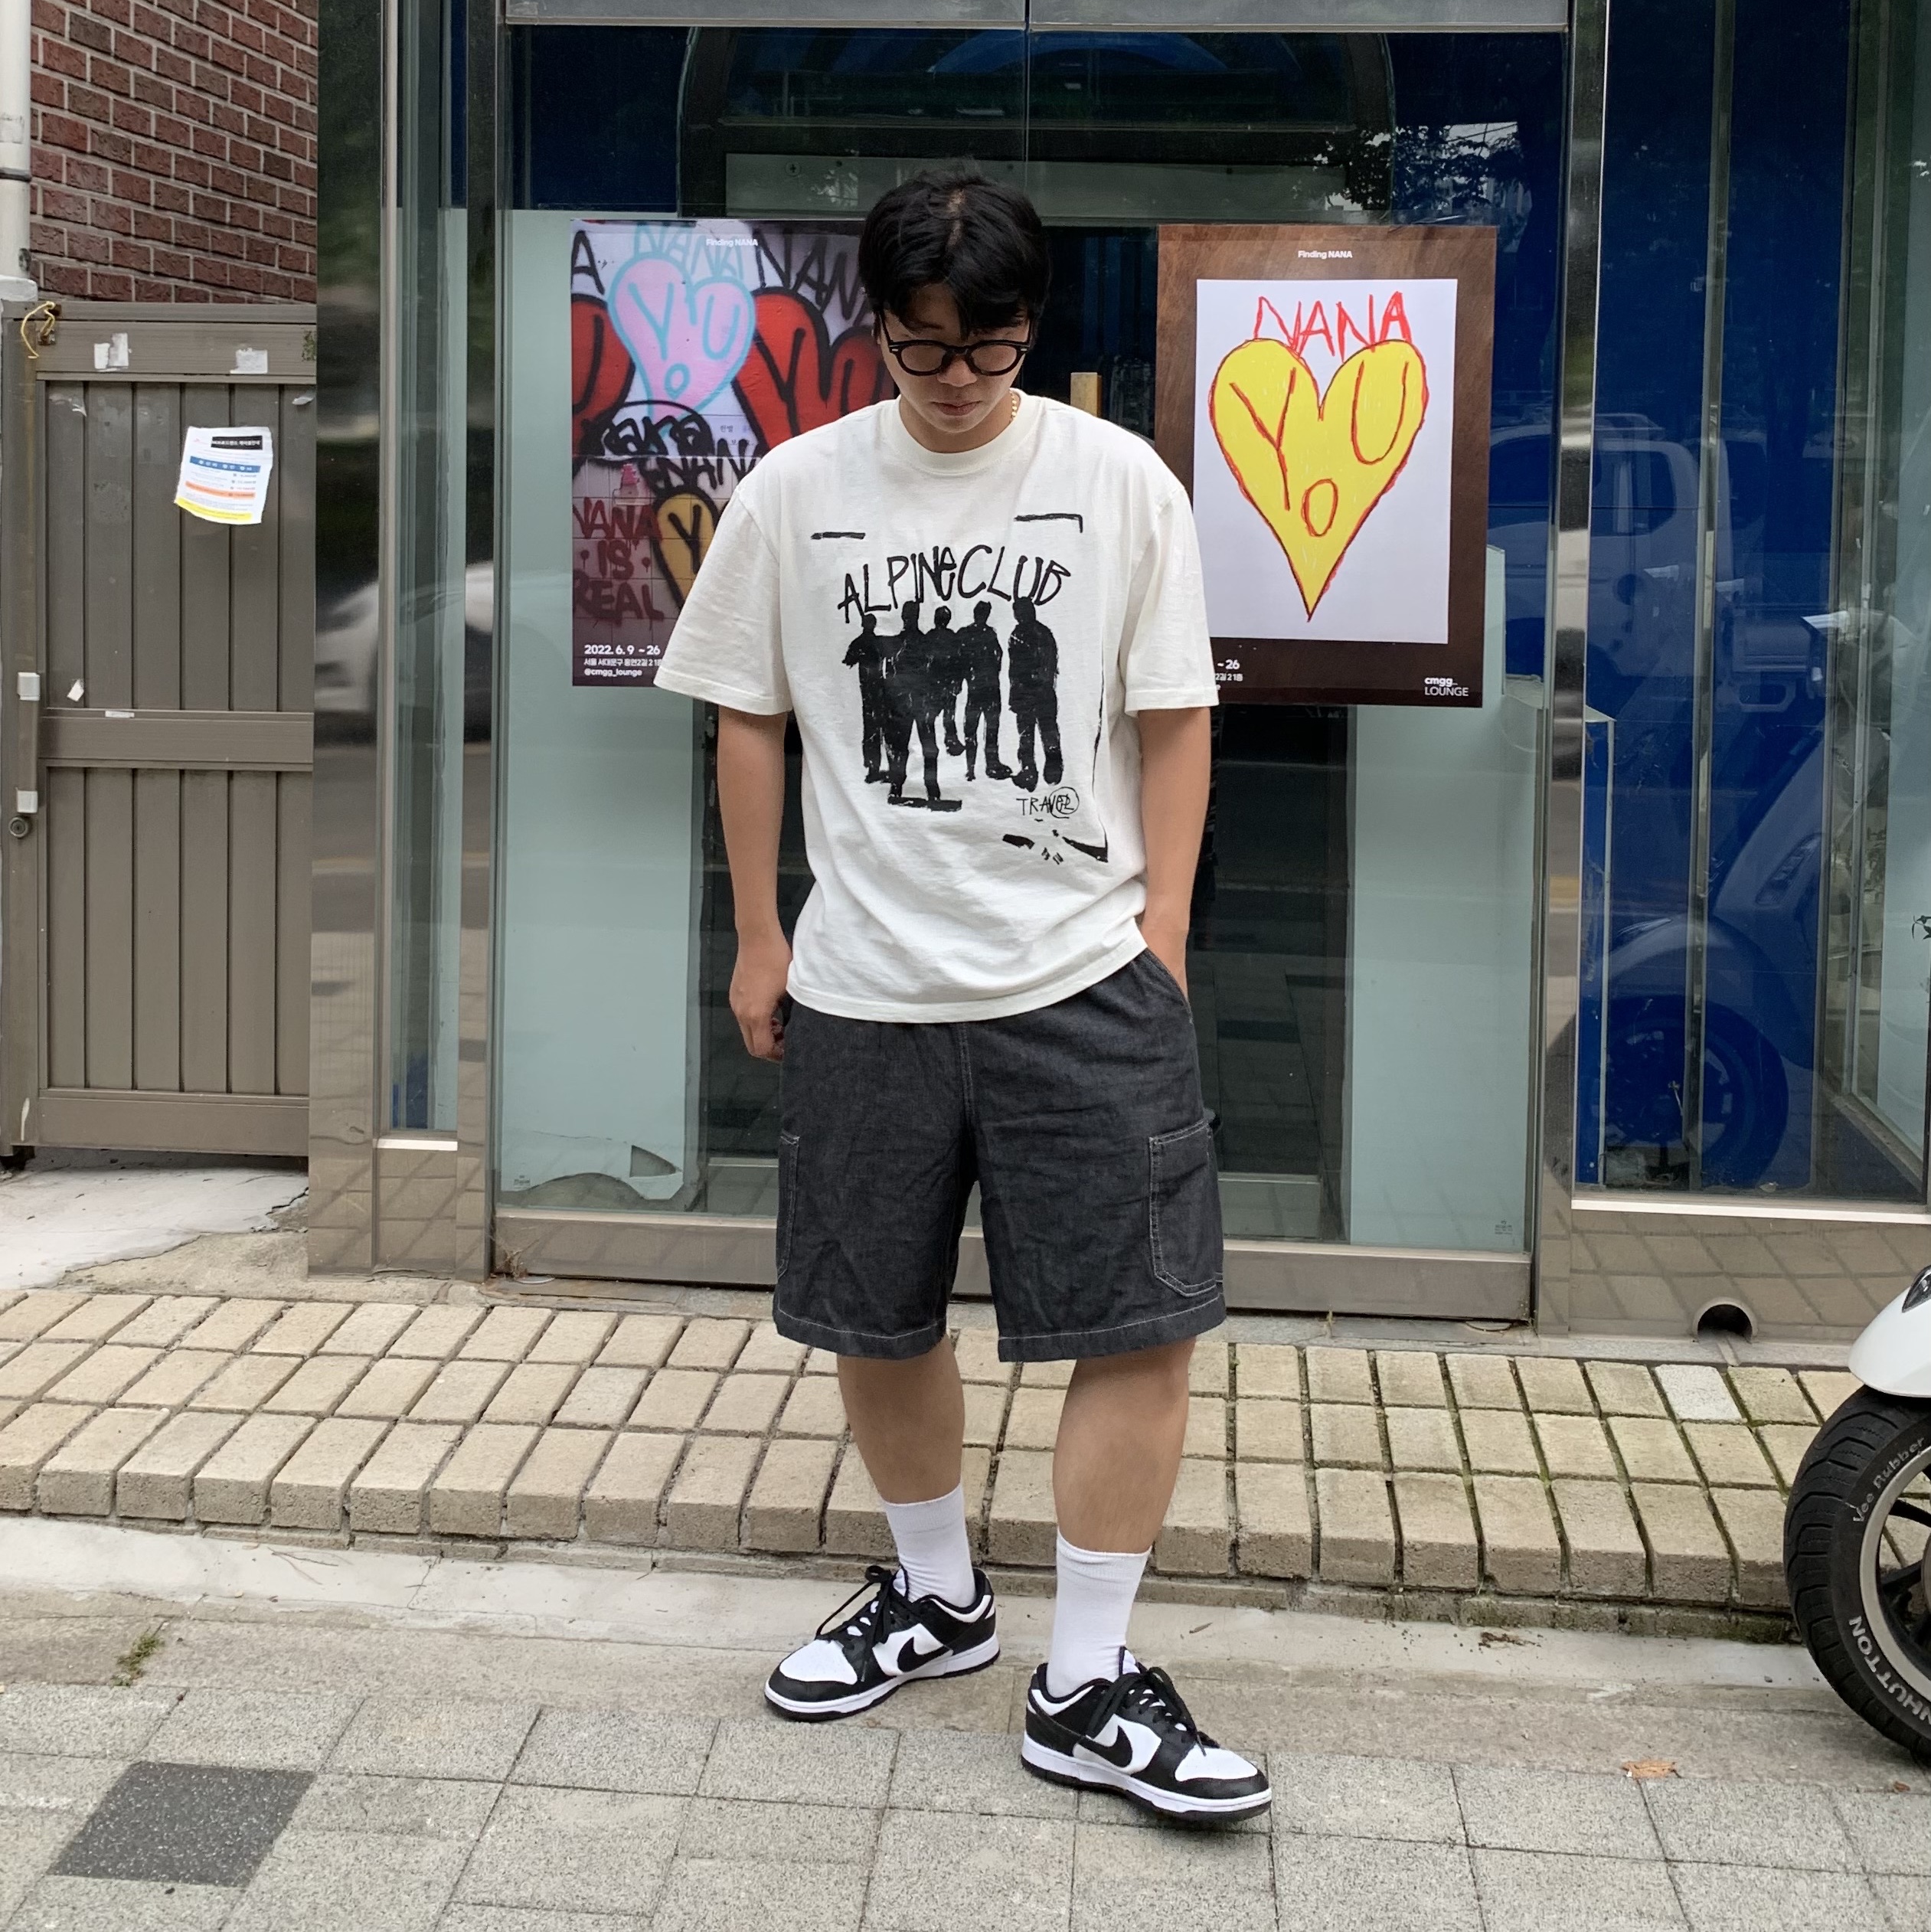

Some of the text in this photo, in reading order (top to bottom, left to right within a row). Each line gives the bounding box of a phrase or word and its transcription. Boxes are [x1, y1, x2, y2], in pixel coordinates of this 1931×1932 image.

[706, 238, 734, 247] Finding
[1298, 250, 1327, 259] Finding
[1253, 291, 1413, 363] NANA
[598, 540, 634, 580] IS
[646, 645, 661, 655] 26
[1225, 659, 1240, 669] 26
[584, 669, 642, 677] @cmgg_lounge
[1424, 686, 1469, 696] LOUNGE
[1872, 1437, 1925, 1489] Rubber
